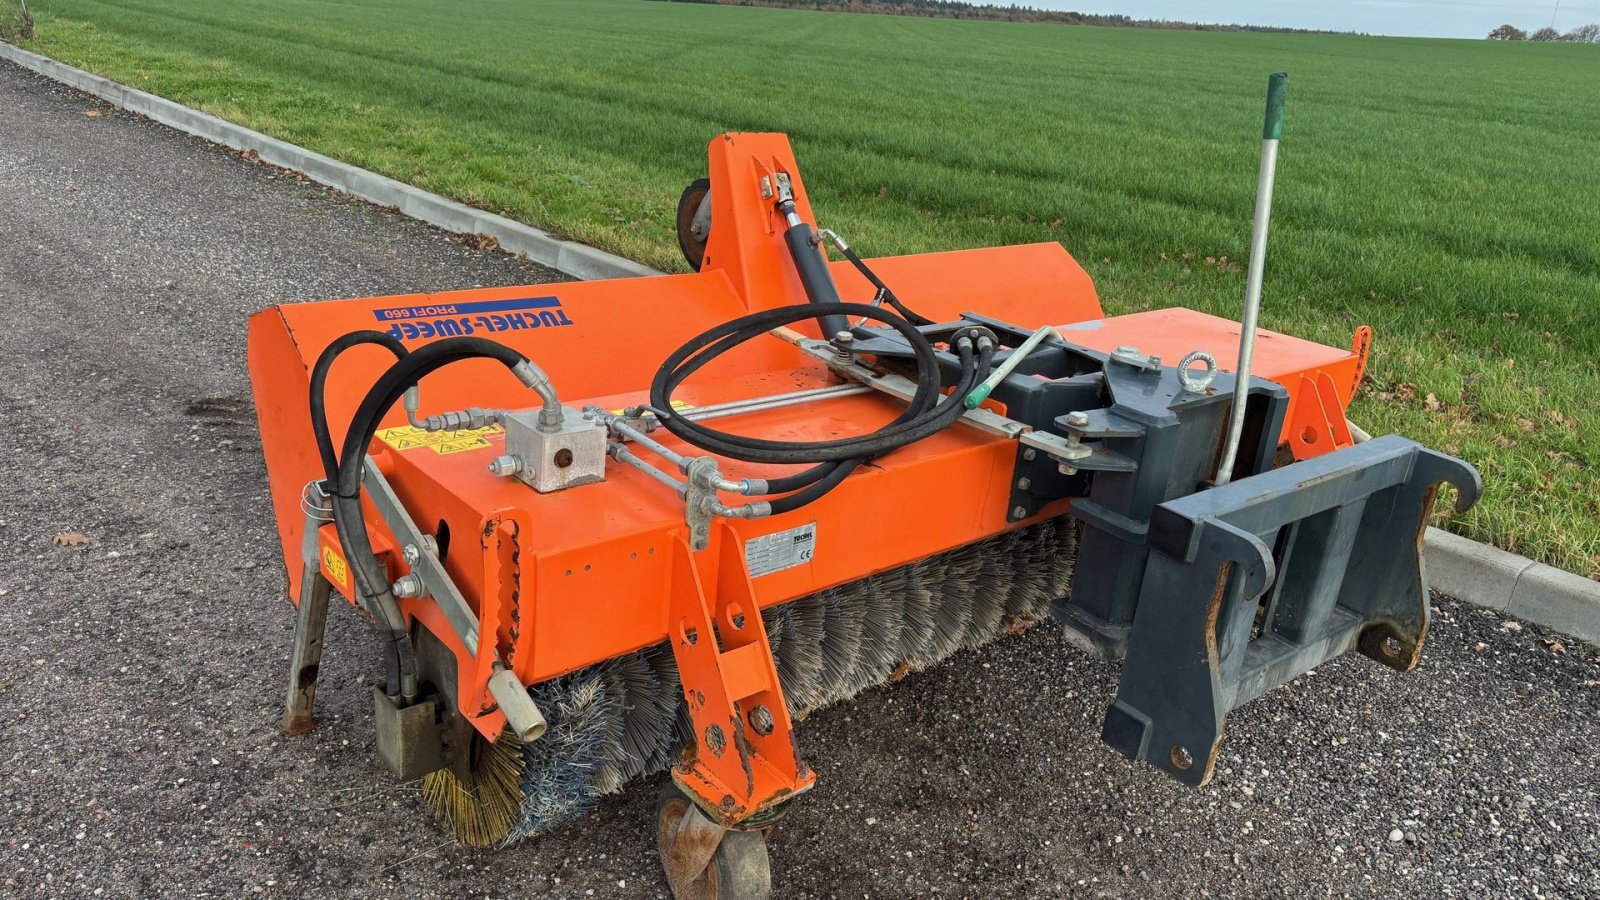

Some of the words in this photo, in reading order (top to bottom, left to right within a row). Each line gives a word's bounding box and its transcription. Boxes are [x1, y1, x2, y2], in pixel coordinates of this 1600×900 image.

[384, 308, 410, 319] 660
[414, 305, 457, 318] PROFI
[386, 309, 574, 342] TUCHEL-SWEEP
[800, 549, 811, 560] CE
